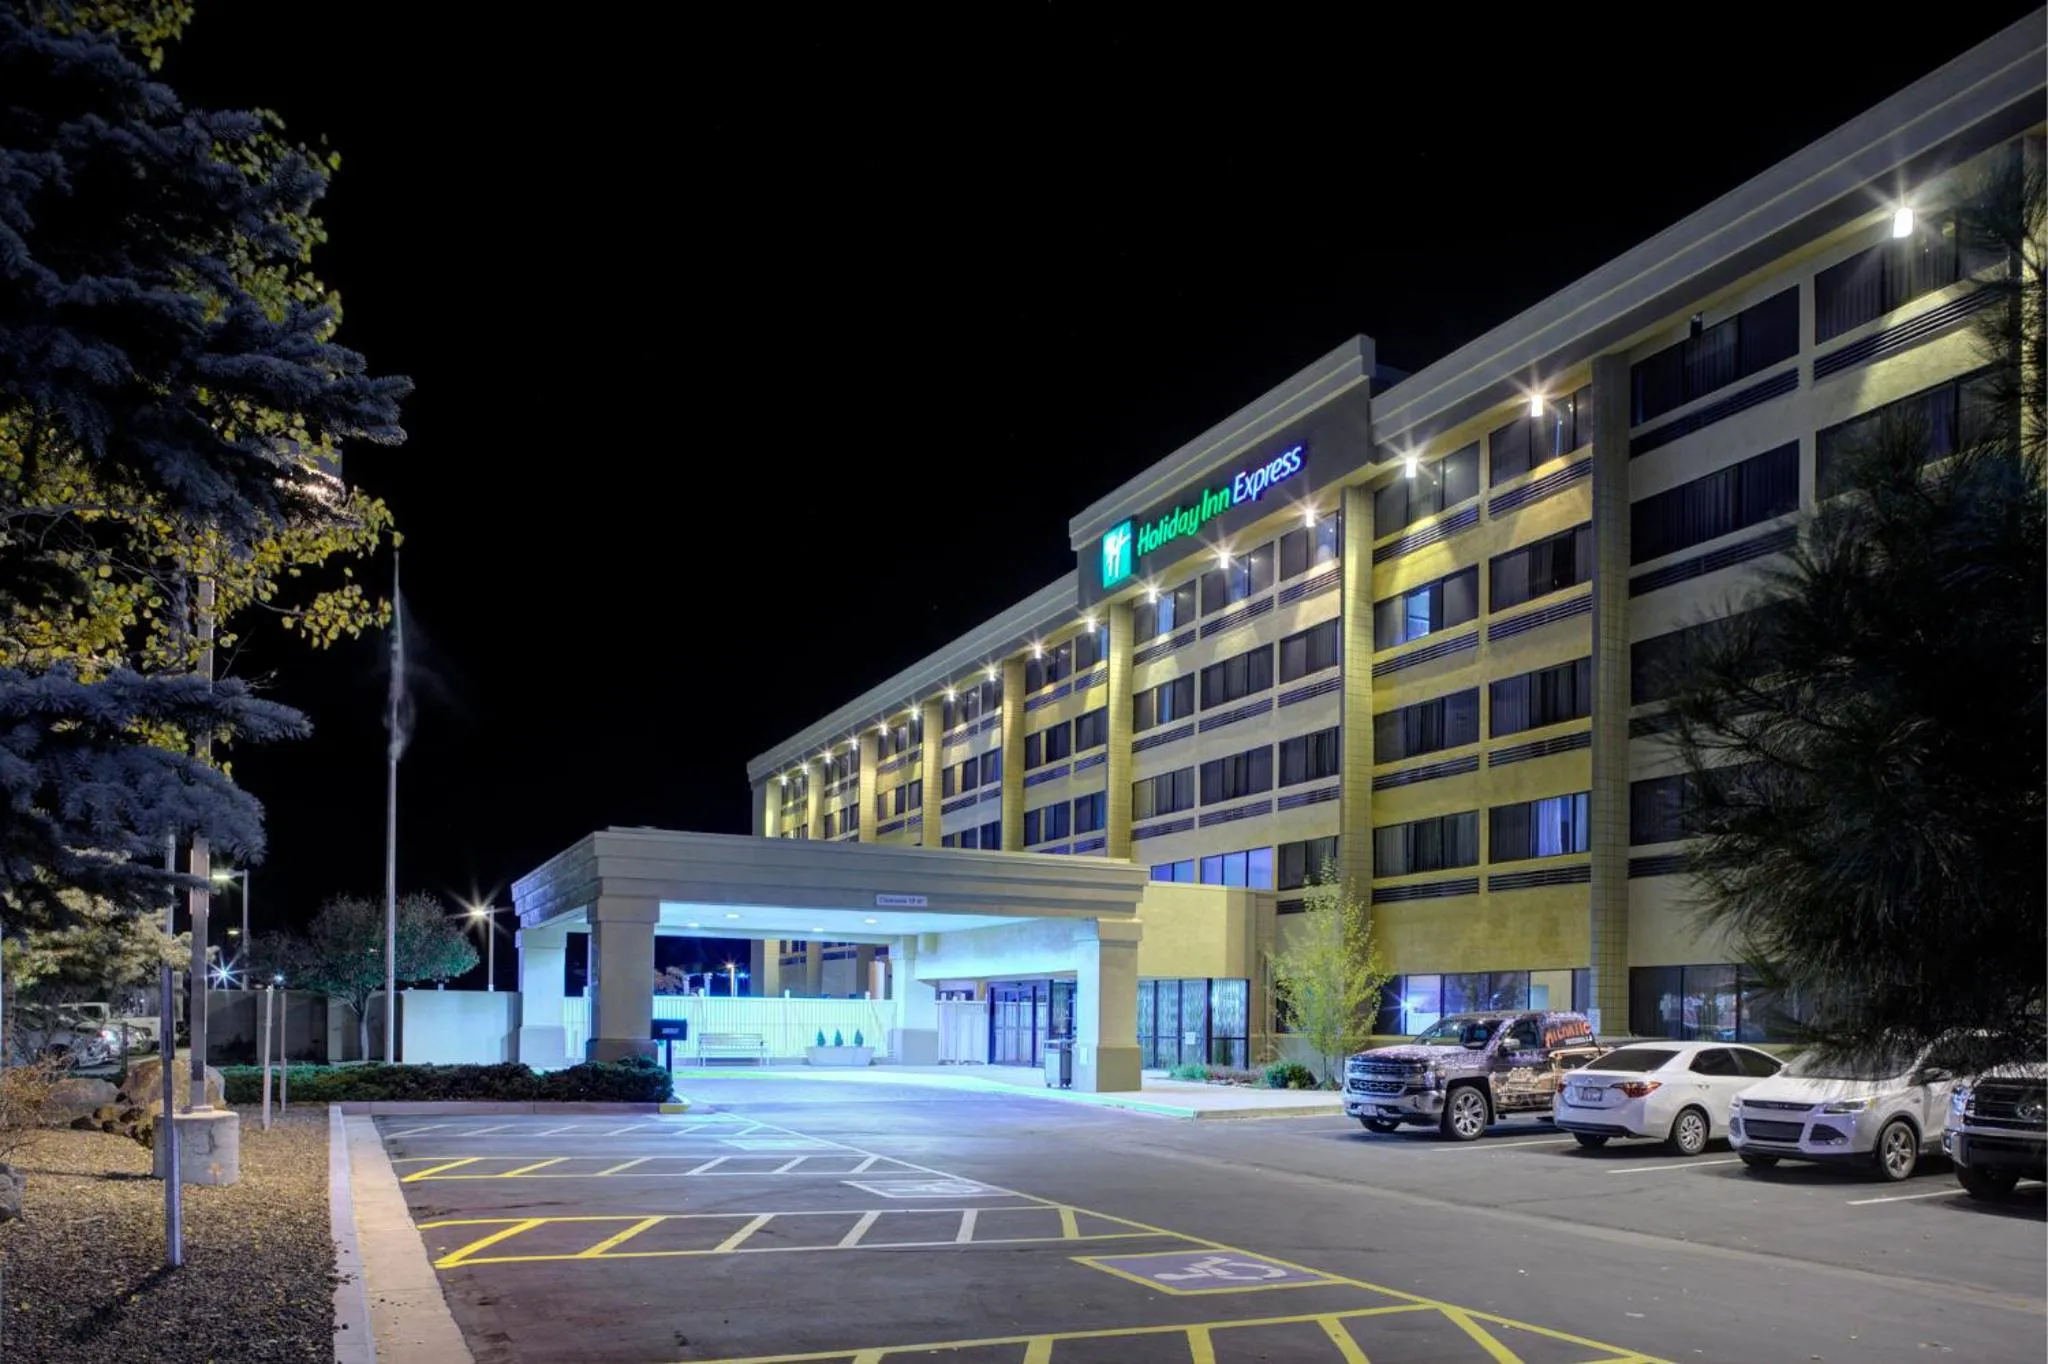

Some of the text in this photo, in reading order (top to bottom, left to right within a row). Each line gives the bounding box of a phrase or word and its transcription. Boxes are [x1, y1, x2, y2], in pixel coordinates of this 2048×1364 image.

[1137, 445, 1303, 557] Holiday Inn Express
